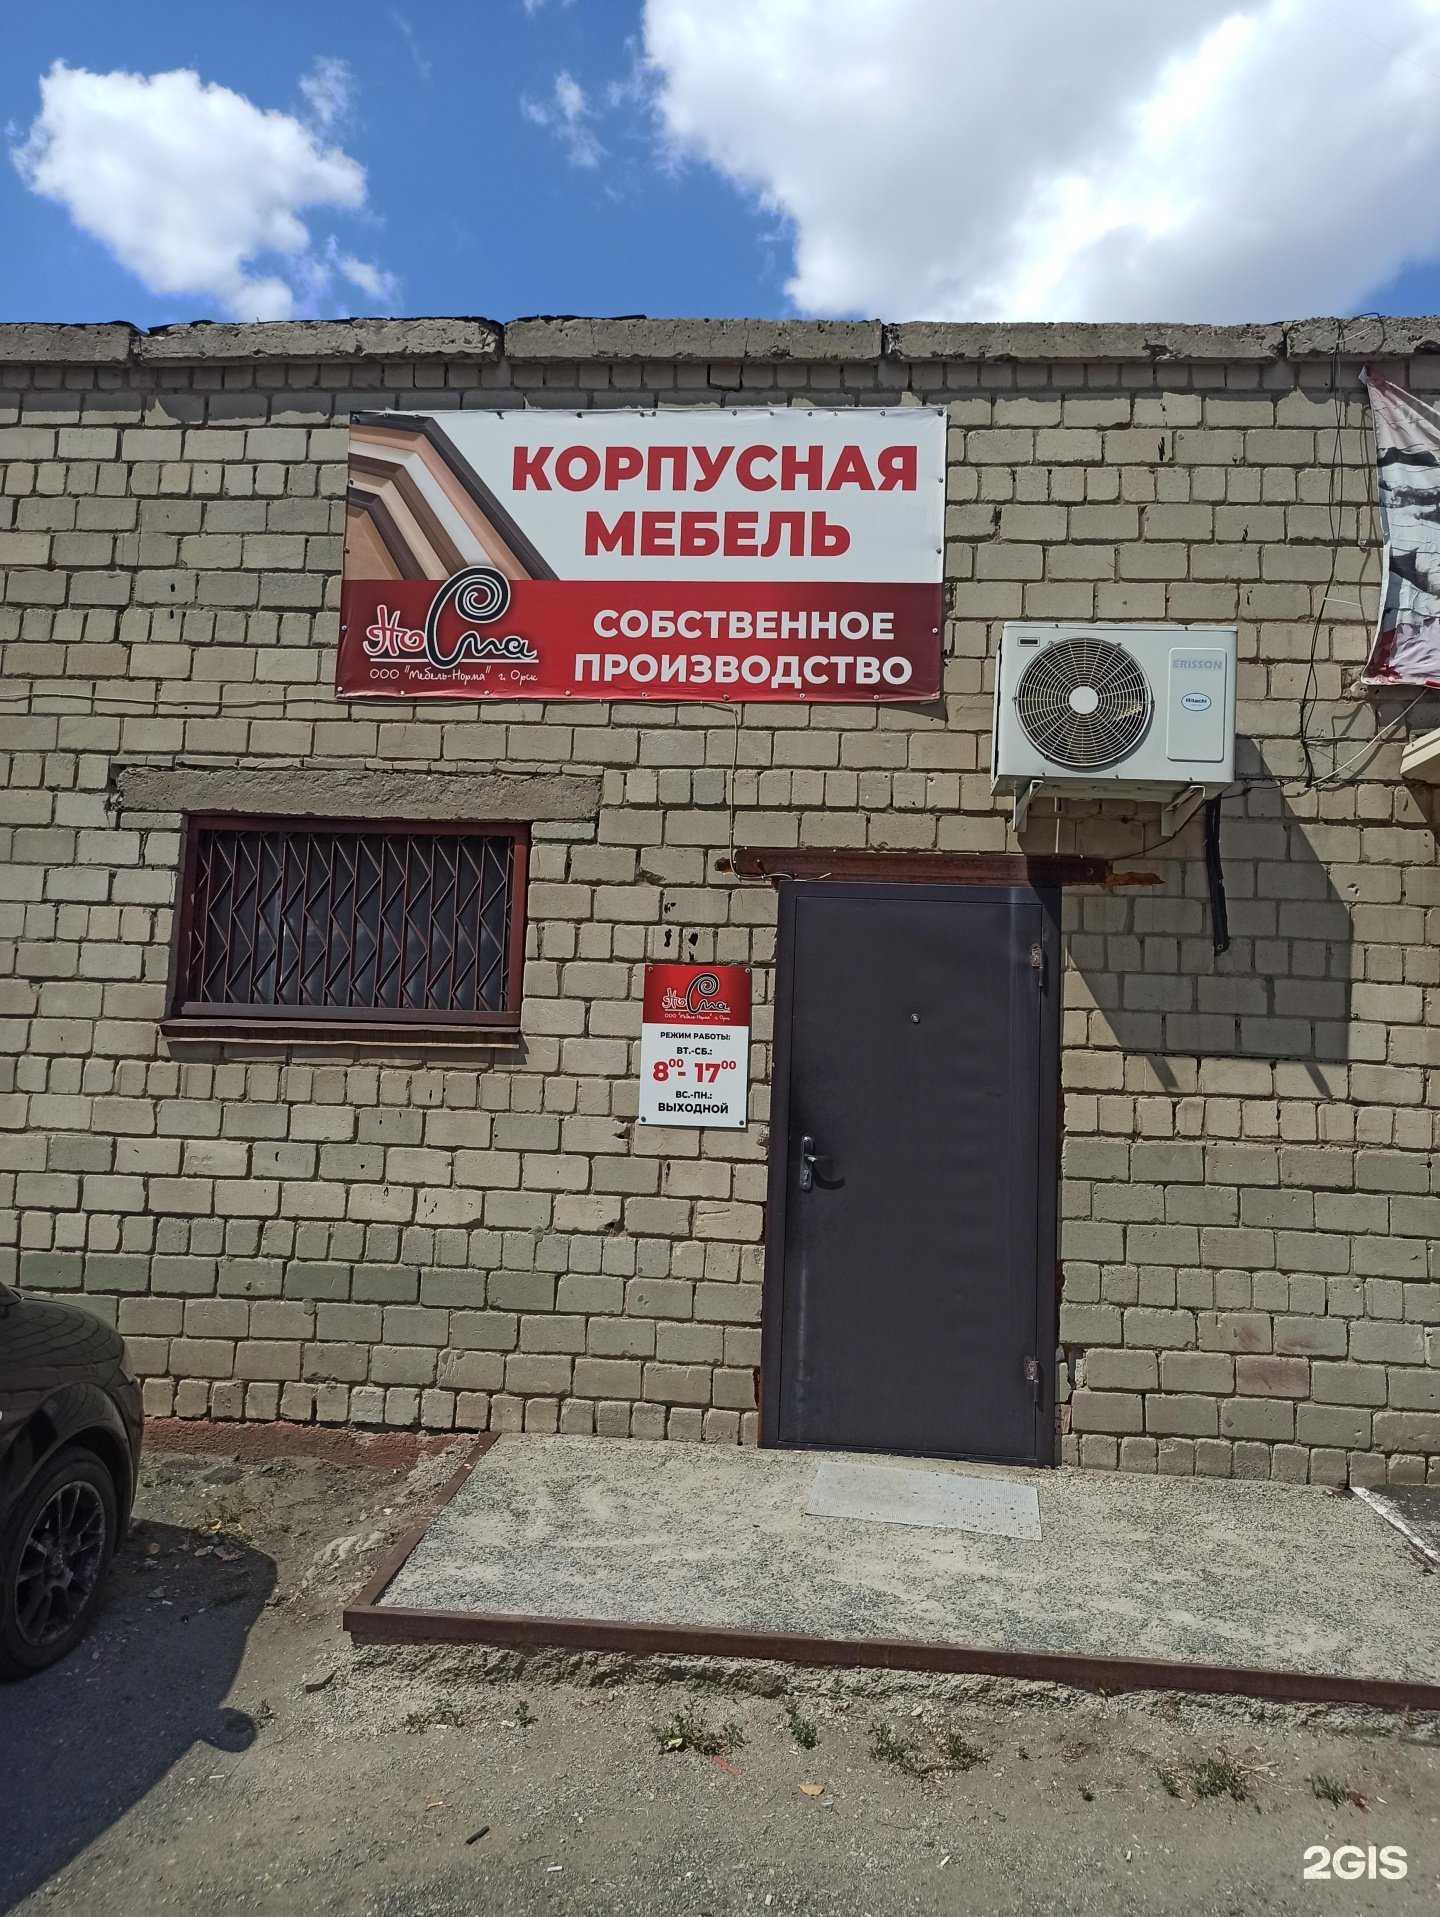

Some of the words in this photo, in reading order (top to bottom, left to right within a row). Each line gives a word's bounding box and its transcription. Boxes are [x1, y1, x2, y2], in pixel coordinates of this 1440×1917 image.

[512, 444, 919, 493] КОРПУСНАЯ
[584, 510, 852, 558] МЕБЕЛЬ
[593, 609, 895, 641] СОБСТВЕННОЕ
[574, 652, 913, 690] ПРОИЗВОДСТВО
[1172, 659, 1223, 670] ERISSON
[369, 668, 400, 680] ООО
[510, 669, 538, 685] Орск
[660, 1031, 692, 1039] РЕЖИМ
[693, 1032, 731, 1041] РАБОТЫ:
[676, 1046, 713, 1056] ВТ.-СБ.:
[675, 1090, 713, 1100] ВС.-ПН.:
[658, 1102, 729, 1115] ВЫХОДНОЙ
